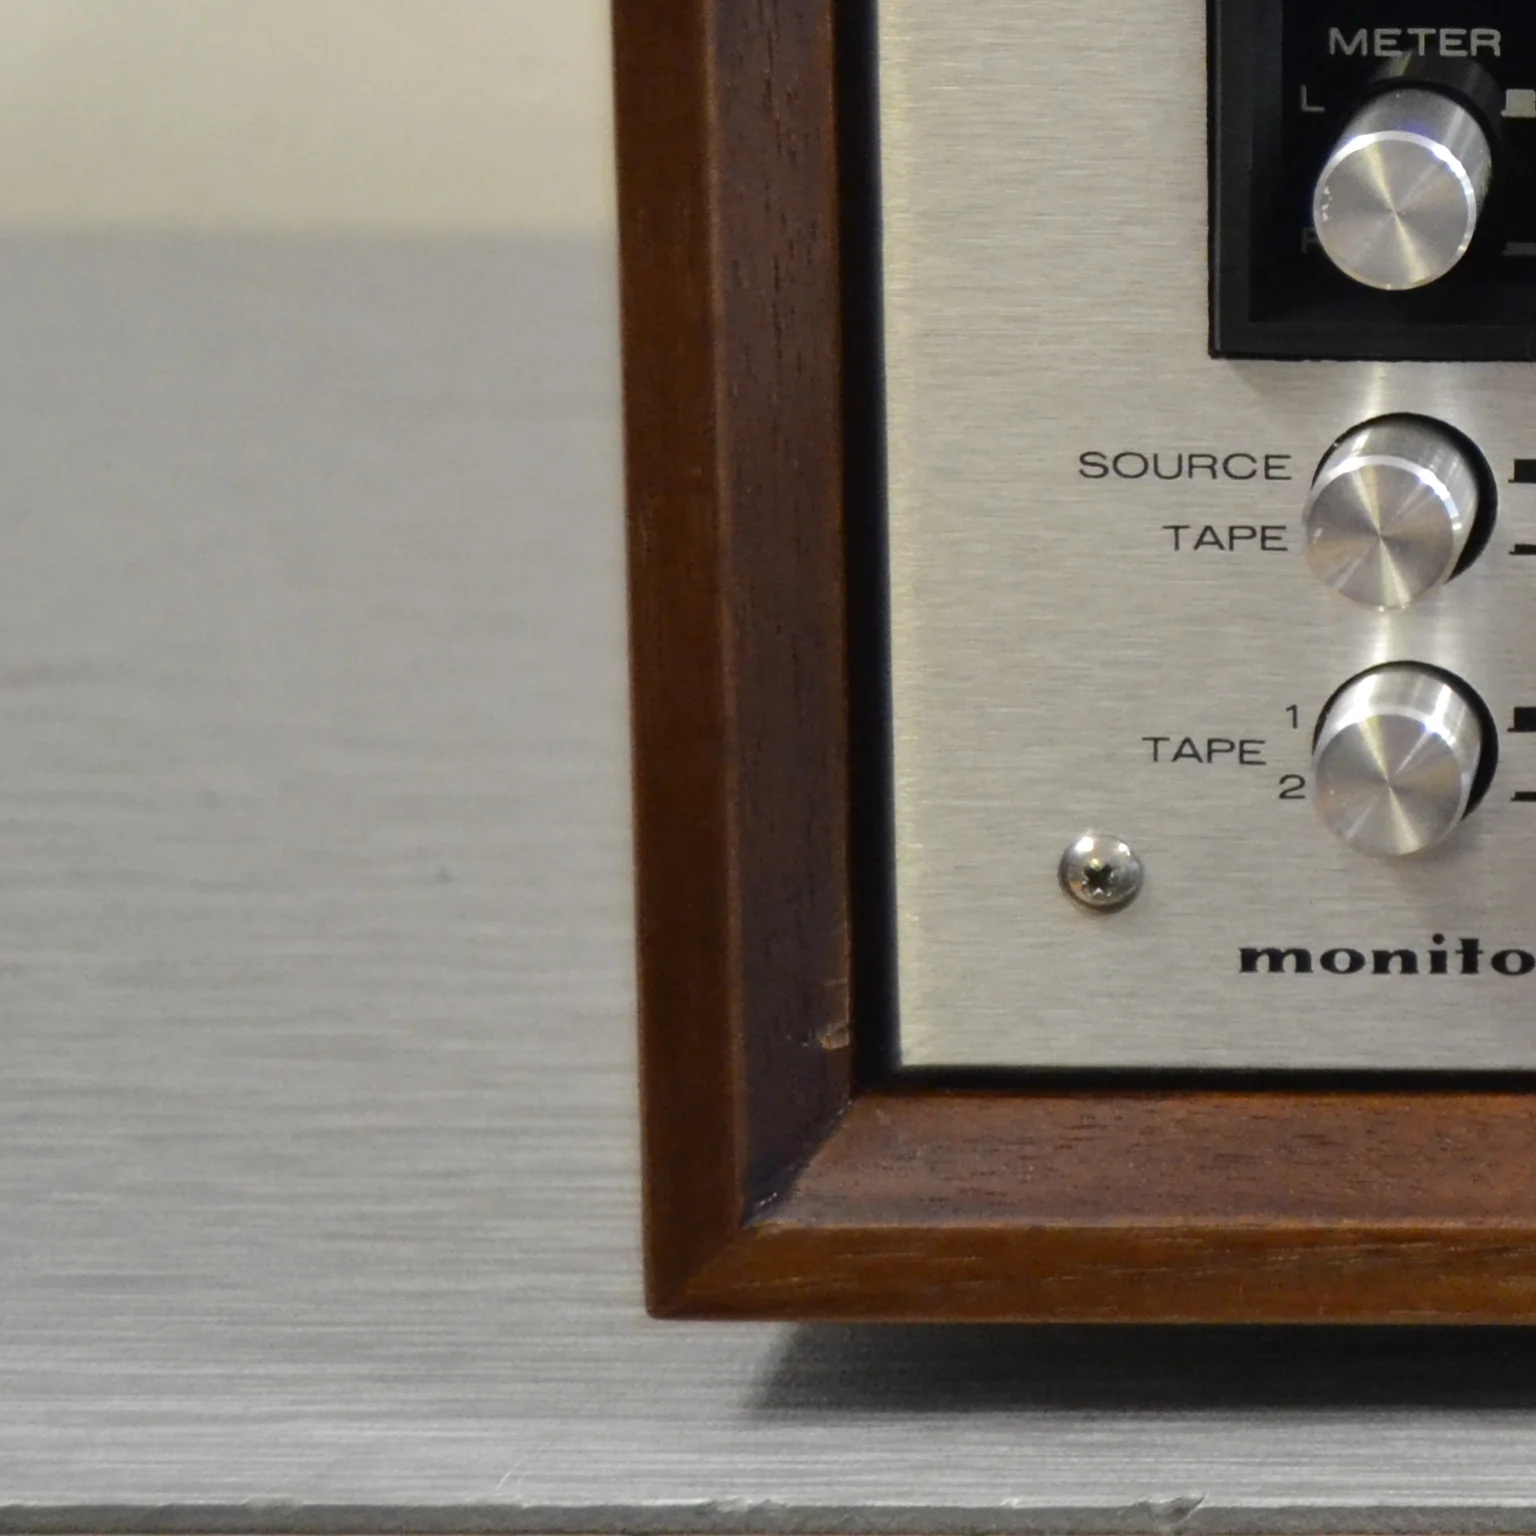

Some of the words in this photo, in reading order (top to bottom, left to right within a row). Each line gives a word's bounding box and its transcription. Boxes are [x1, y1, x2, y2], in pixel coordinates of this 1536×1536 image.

[1328, 27, 1503, 58] METER
[1301, 84, 1326, 112] L
[1078, 451, 1293, 482] SOURCE
[1162, 524, 1289, 552] TAPE
[1285, 704, 1301, 730] 1
[1142, 737, 1267, 766] TAPE
[1278, 774, 1307, 801] 2
